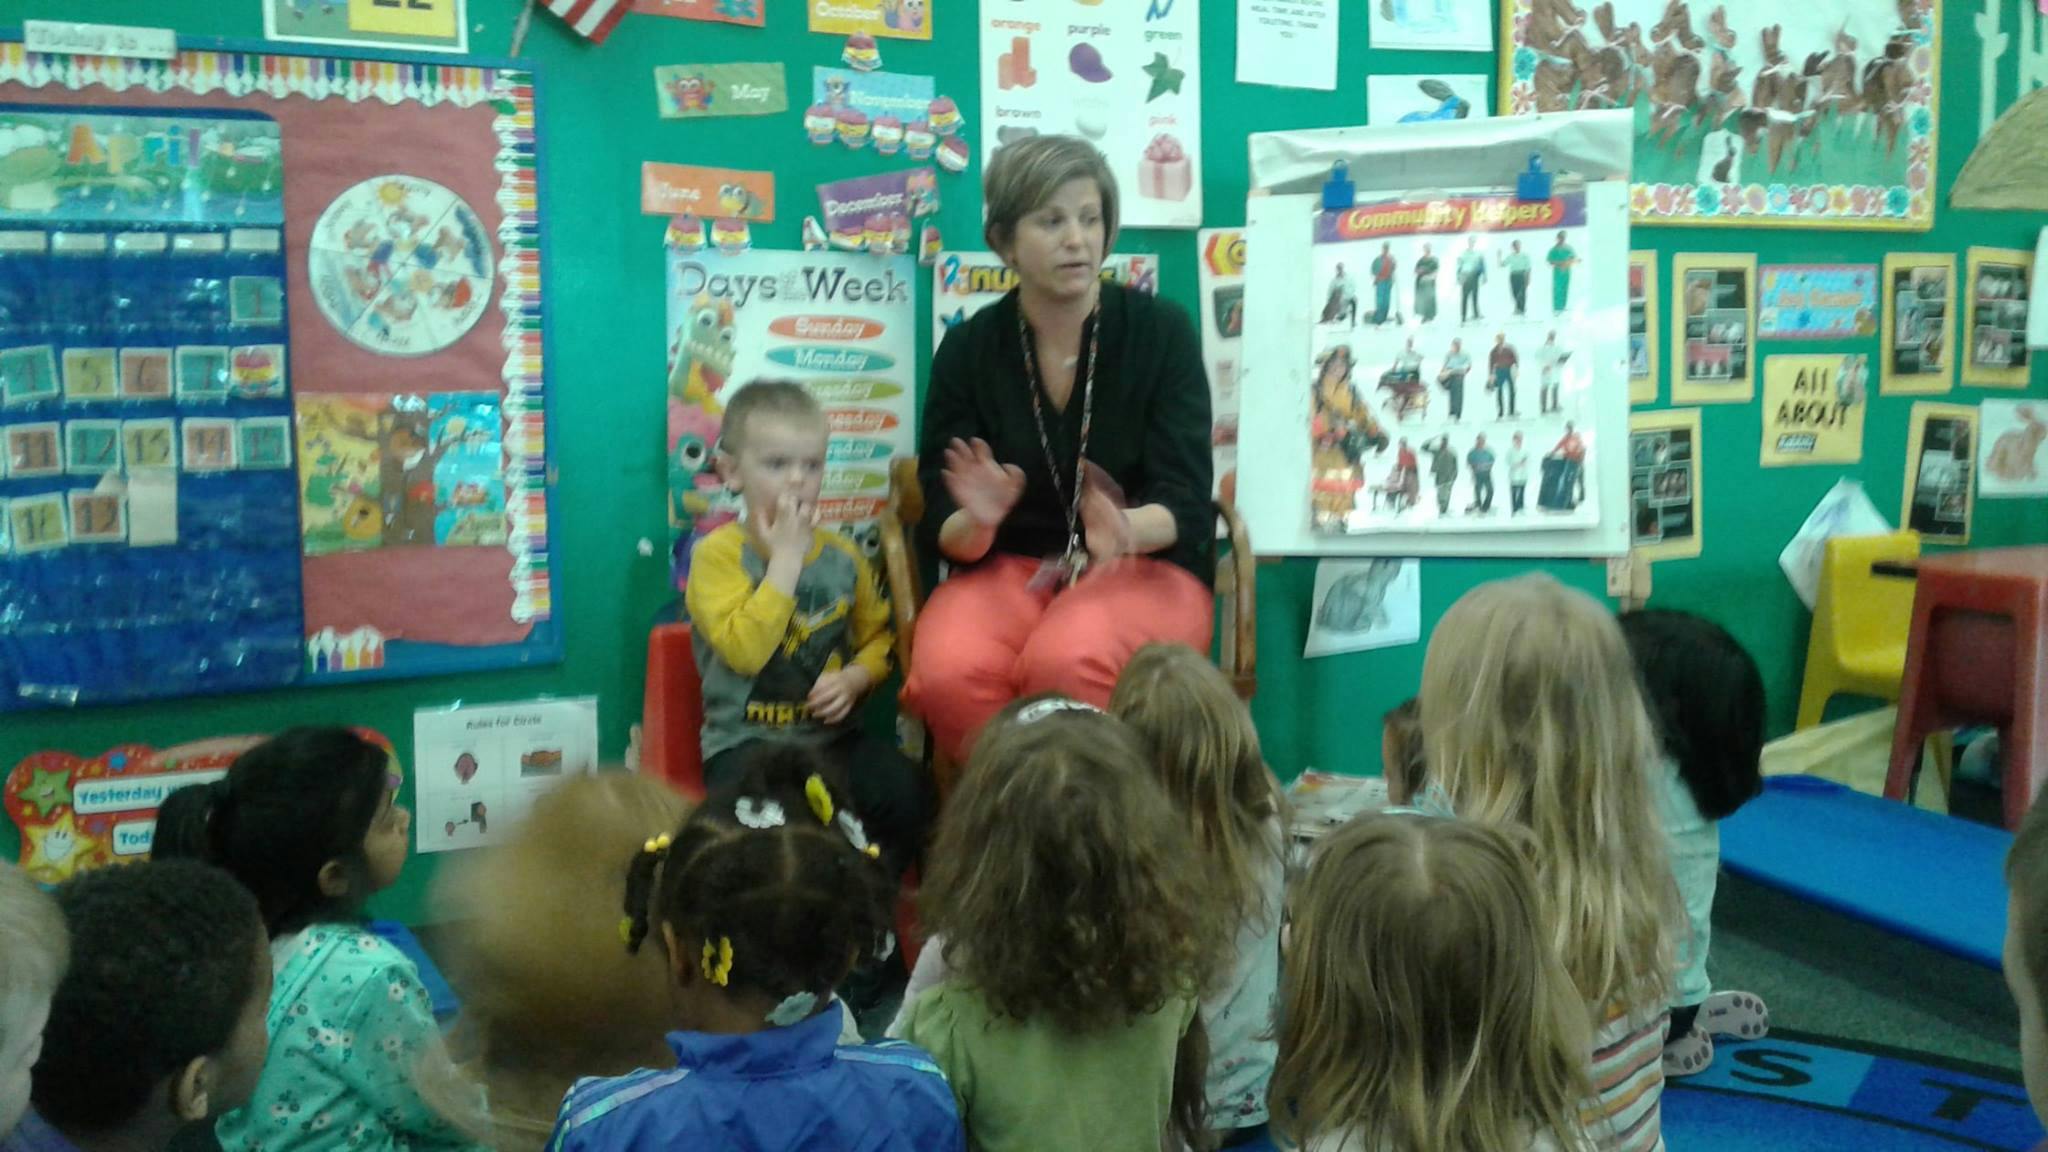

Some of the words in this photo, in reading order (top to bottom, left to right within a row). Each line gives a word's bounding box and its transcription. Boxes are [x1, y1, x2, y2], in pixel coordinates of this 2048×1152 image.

[991, 18, 1041, 35] orange
[1067, 24, 1111, 36] purple
[1144, 30, 1182, 42] green
[730, 84, 771, 103] May
[996, 106, 1041, 119] brown
[1149, 114, 1177, 126] pink
[67, 125, 200, 174] April
[659, 181, 700, 201] June
[826, 192, 904, 216] December
[1349, 203, 1465, 231] Community
[677, 260, 777, 308] Days
[802, 265, 908, 303] Week
[795, 317, 865, 339] Sunday
[794, 348, 868, 370] Monday
[1775, 399, 1850, 429] ABOUT
[79, 786, 162, 805] Yesterday
[120, 831, 151, 846] Tod
[1730, 1048, 1813, 1087] S
[1920, 1078, 2031, 1122] T
